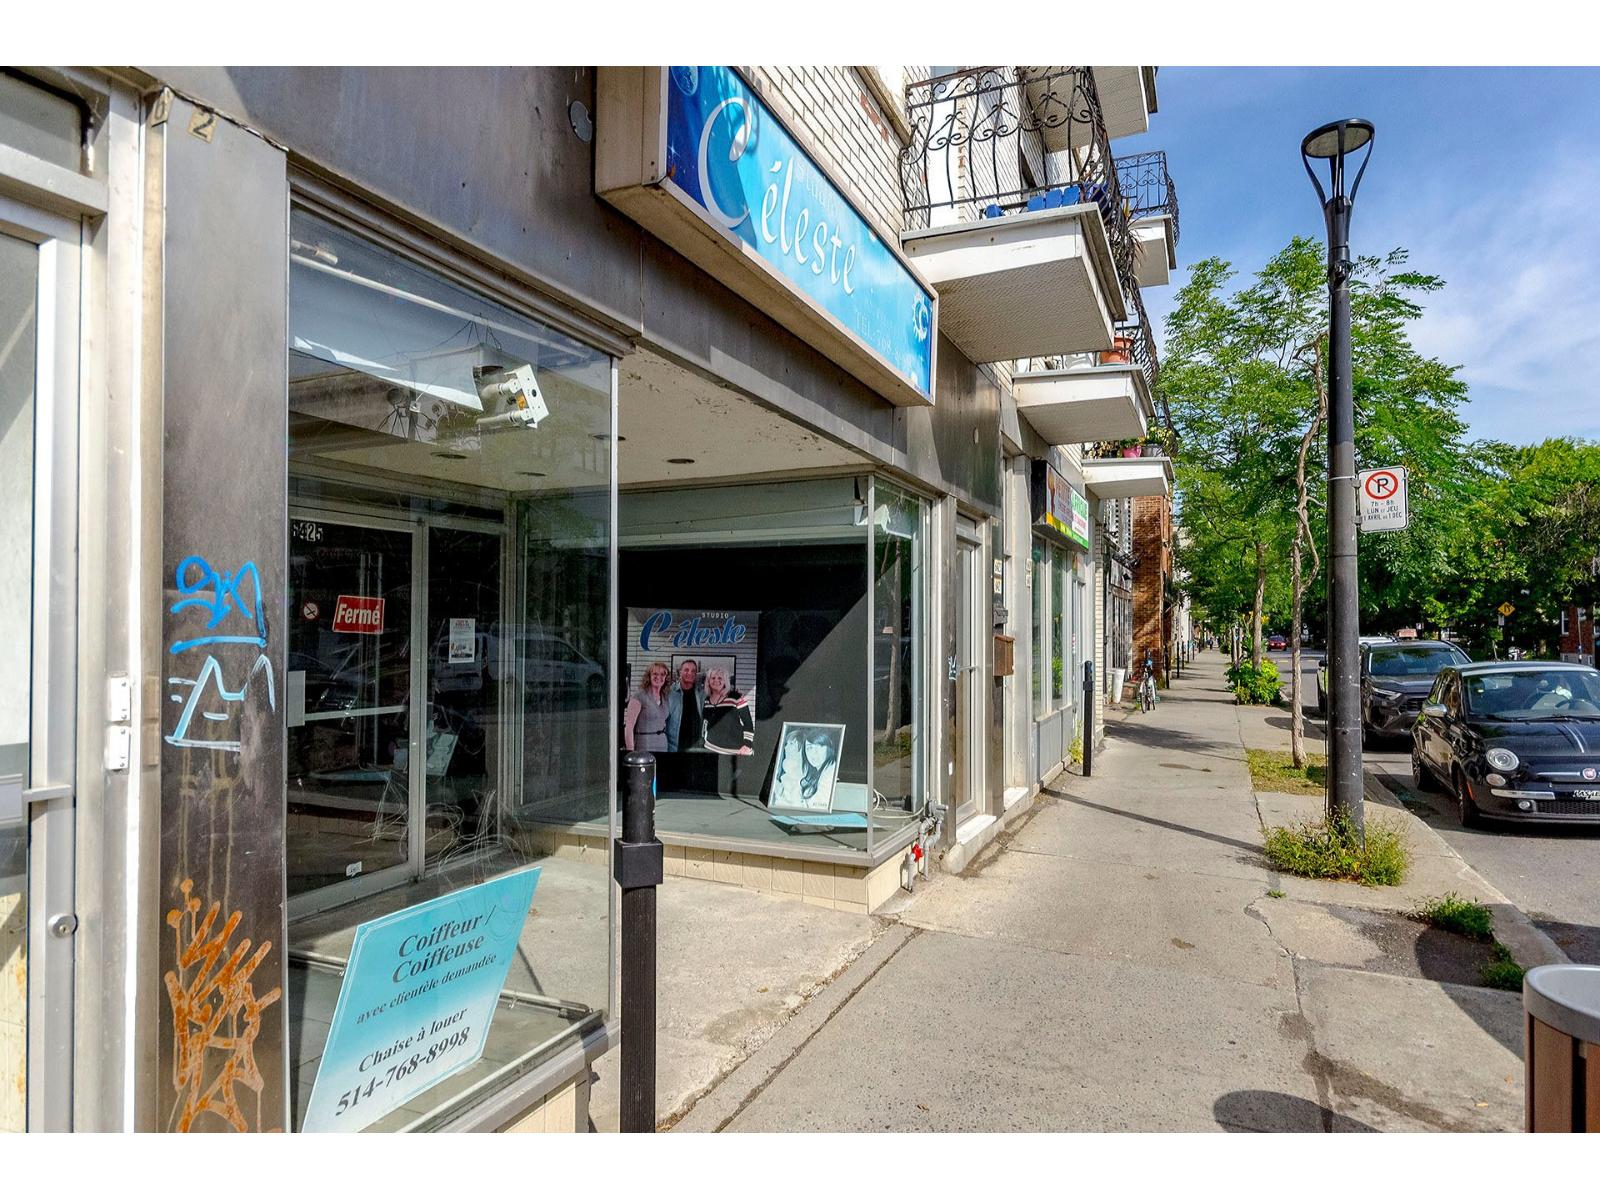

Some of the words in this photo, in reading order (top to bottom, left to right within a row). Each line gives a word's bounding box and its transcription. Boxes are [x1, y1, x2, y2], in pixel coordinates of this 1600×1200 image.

[698, 97, 855, 294] Céleste
[1387, 505, 1399, 513] JEU
[337, 603, 380, 625] Fermé
[639, 610, 746, 652] Céleste
[393, 935, 484, 983] Coiffeuse
[356, 1003, 387, 1025] avec
[389, 978, 439, 1009] clientèle
[441, 953, 497, 985] demandée
[359, 1036, 413, 1073] Chaise
[416, 1026, 425, 1042] à
[430, 1008, 467, 1036] louer
[335, 1026, 470, 1116] 514-768-8998
